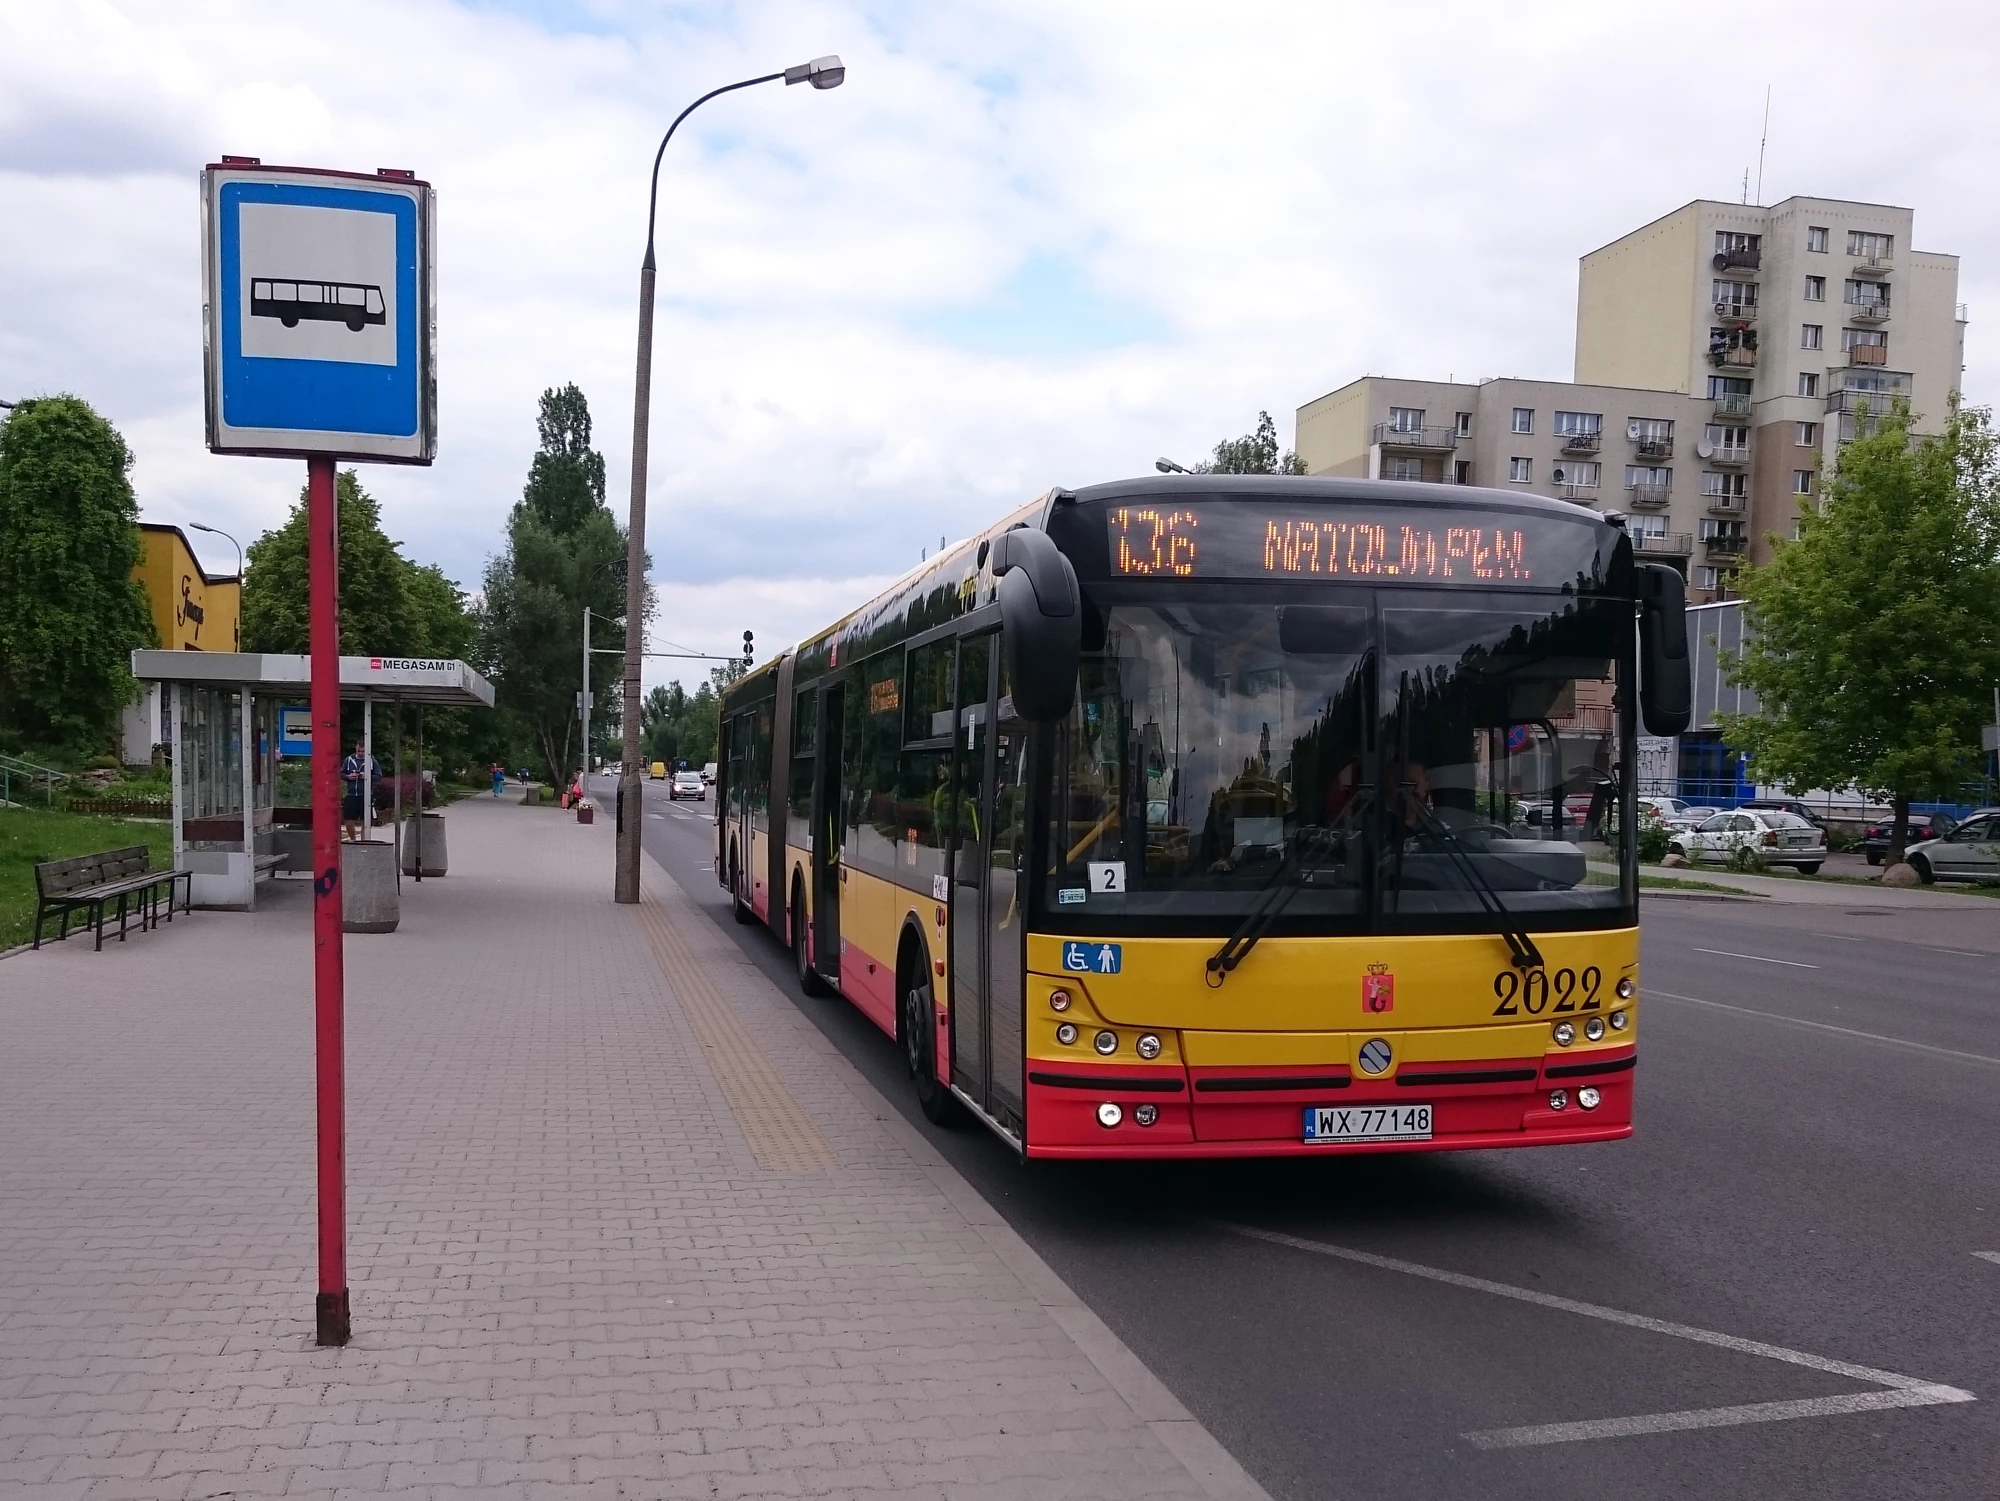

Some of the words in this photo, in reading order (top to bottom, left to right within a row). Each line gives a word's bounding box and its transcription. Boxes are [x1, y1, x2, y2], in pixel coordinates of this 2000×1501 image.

[1111, 508, 1197, 575] 136
[383, 660, 445, 671] MEGASAM
[1104, 869, 1116, 889] 2
[1492, 966, 1601, 1016] 2022
[1319, 1111, 1351, 1134] WX
[1360, 1108, 1429, 1133] 77148
